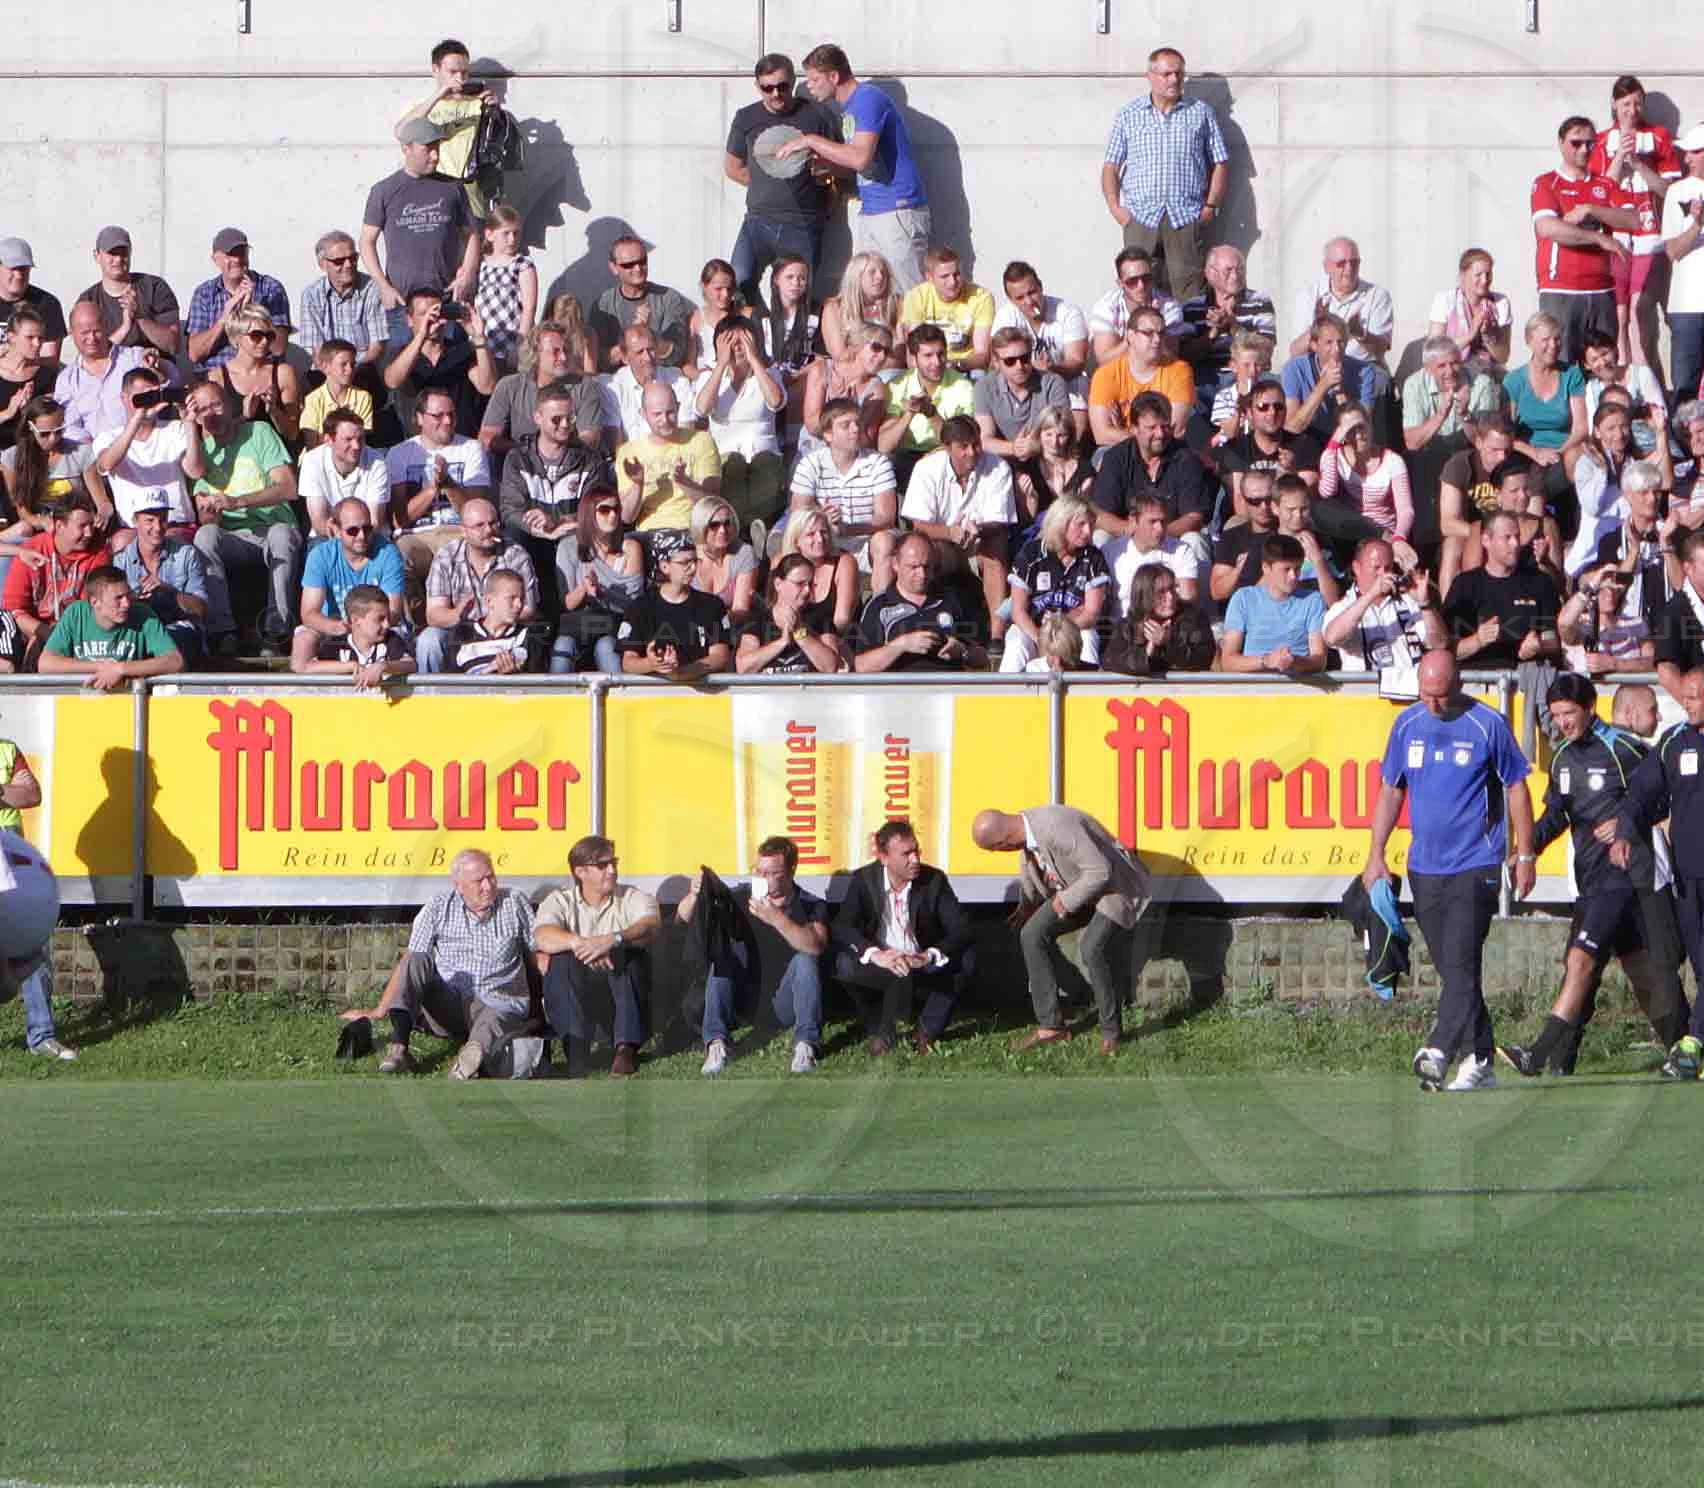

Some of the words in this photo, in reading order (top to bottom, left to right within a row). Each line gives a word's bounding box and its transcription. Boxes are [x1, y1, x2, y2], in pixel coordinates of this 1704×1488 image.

[206, 698, 582, 870] Murauer
[1104, 697, 1409, 850] Murau
[283, 847, 349, 867] Rein
[365, 846, 413, 867] das
[1184, 845, 1247, 865] Rein
[1262, 845, 1311, 866] das
[1328, 845, 1406, 866] Bee
